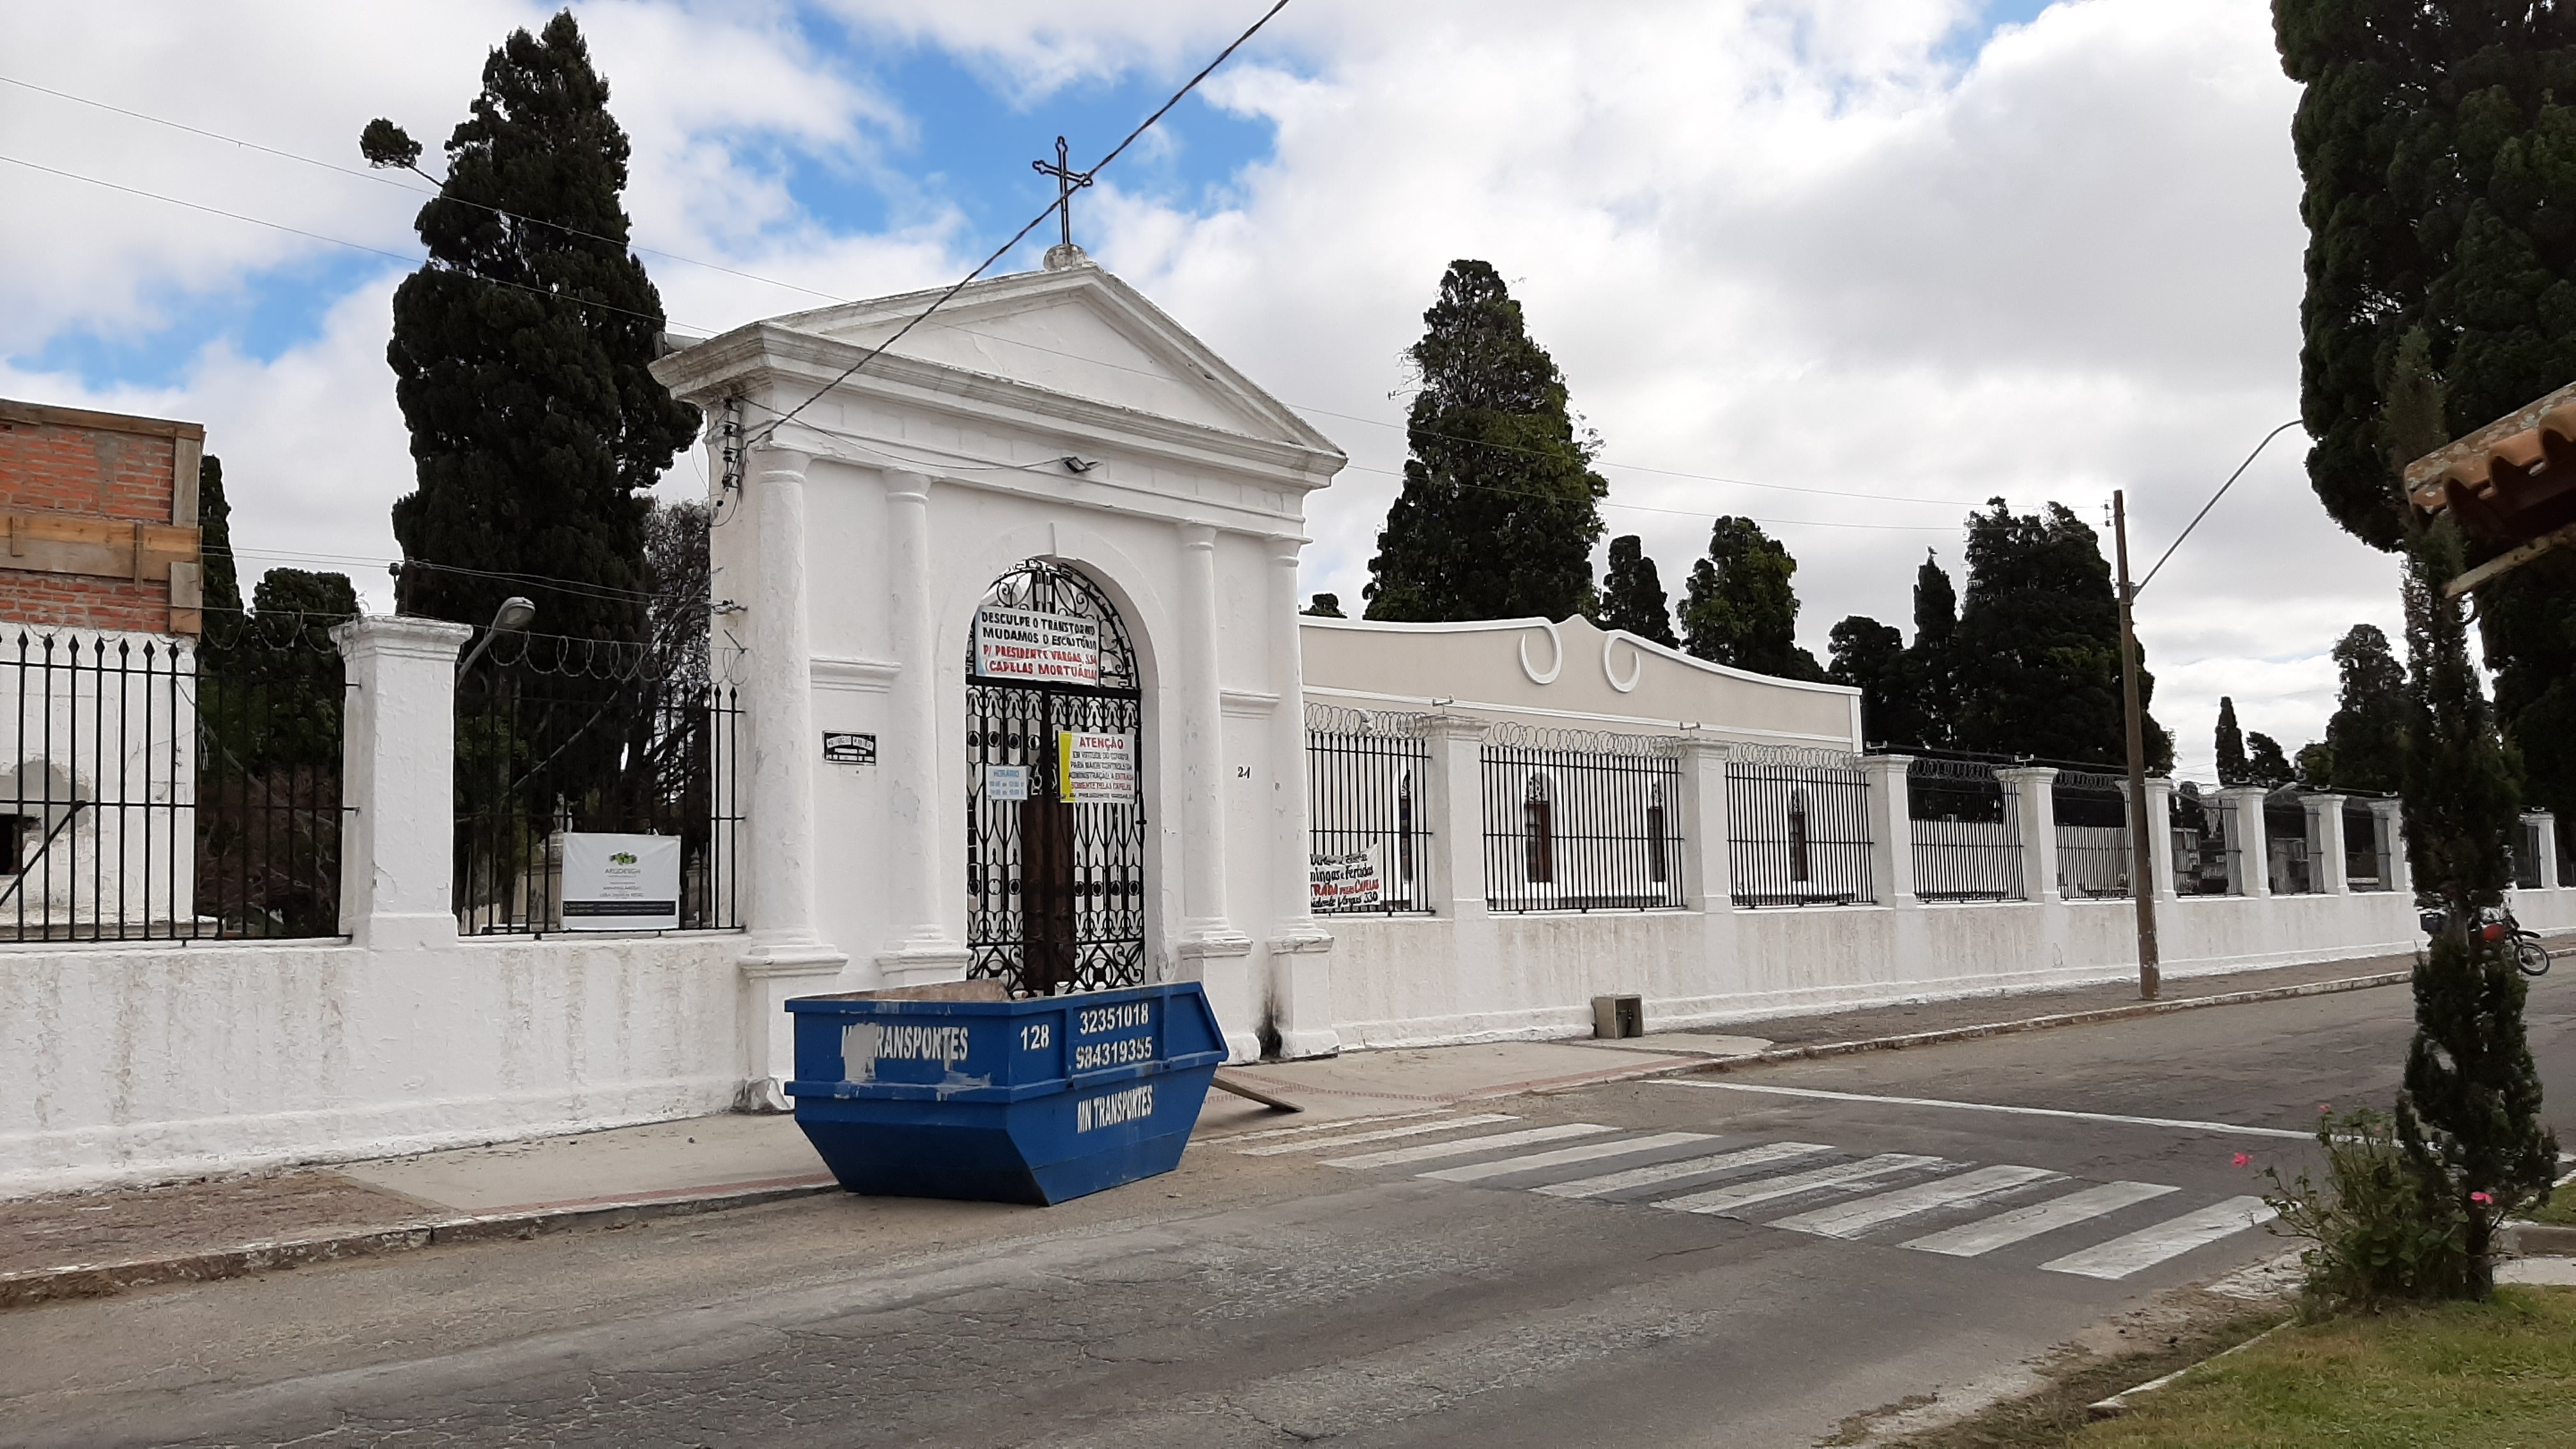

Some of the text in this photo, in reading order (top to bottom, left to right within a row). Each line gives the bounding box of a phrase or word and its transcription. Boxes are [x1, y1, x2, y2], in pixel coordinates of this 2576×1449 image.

[981, 611, 1095, 636] DESCULPE O TRANSTORNO
[983, 627, 1039, 644] MUDAMOS
[1043, 635, 1049, 645] O
[995, 645, 1048, 659] PRESIDENTE
[1079, 737, 1124, 751] ATENÇÃO
[1080, 1002, 1149, 1035] 32351018
[875, 1025, 969, 1061] RANSPORTES
[1020, 1024, 1050, 1051] 128
[1076, 1036, 1152, 1070] 984319355
[1094, 1084, 1153, 1129] TRANSPORTES
